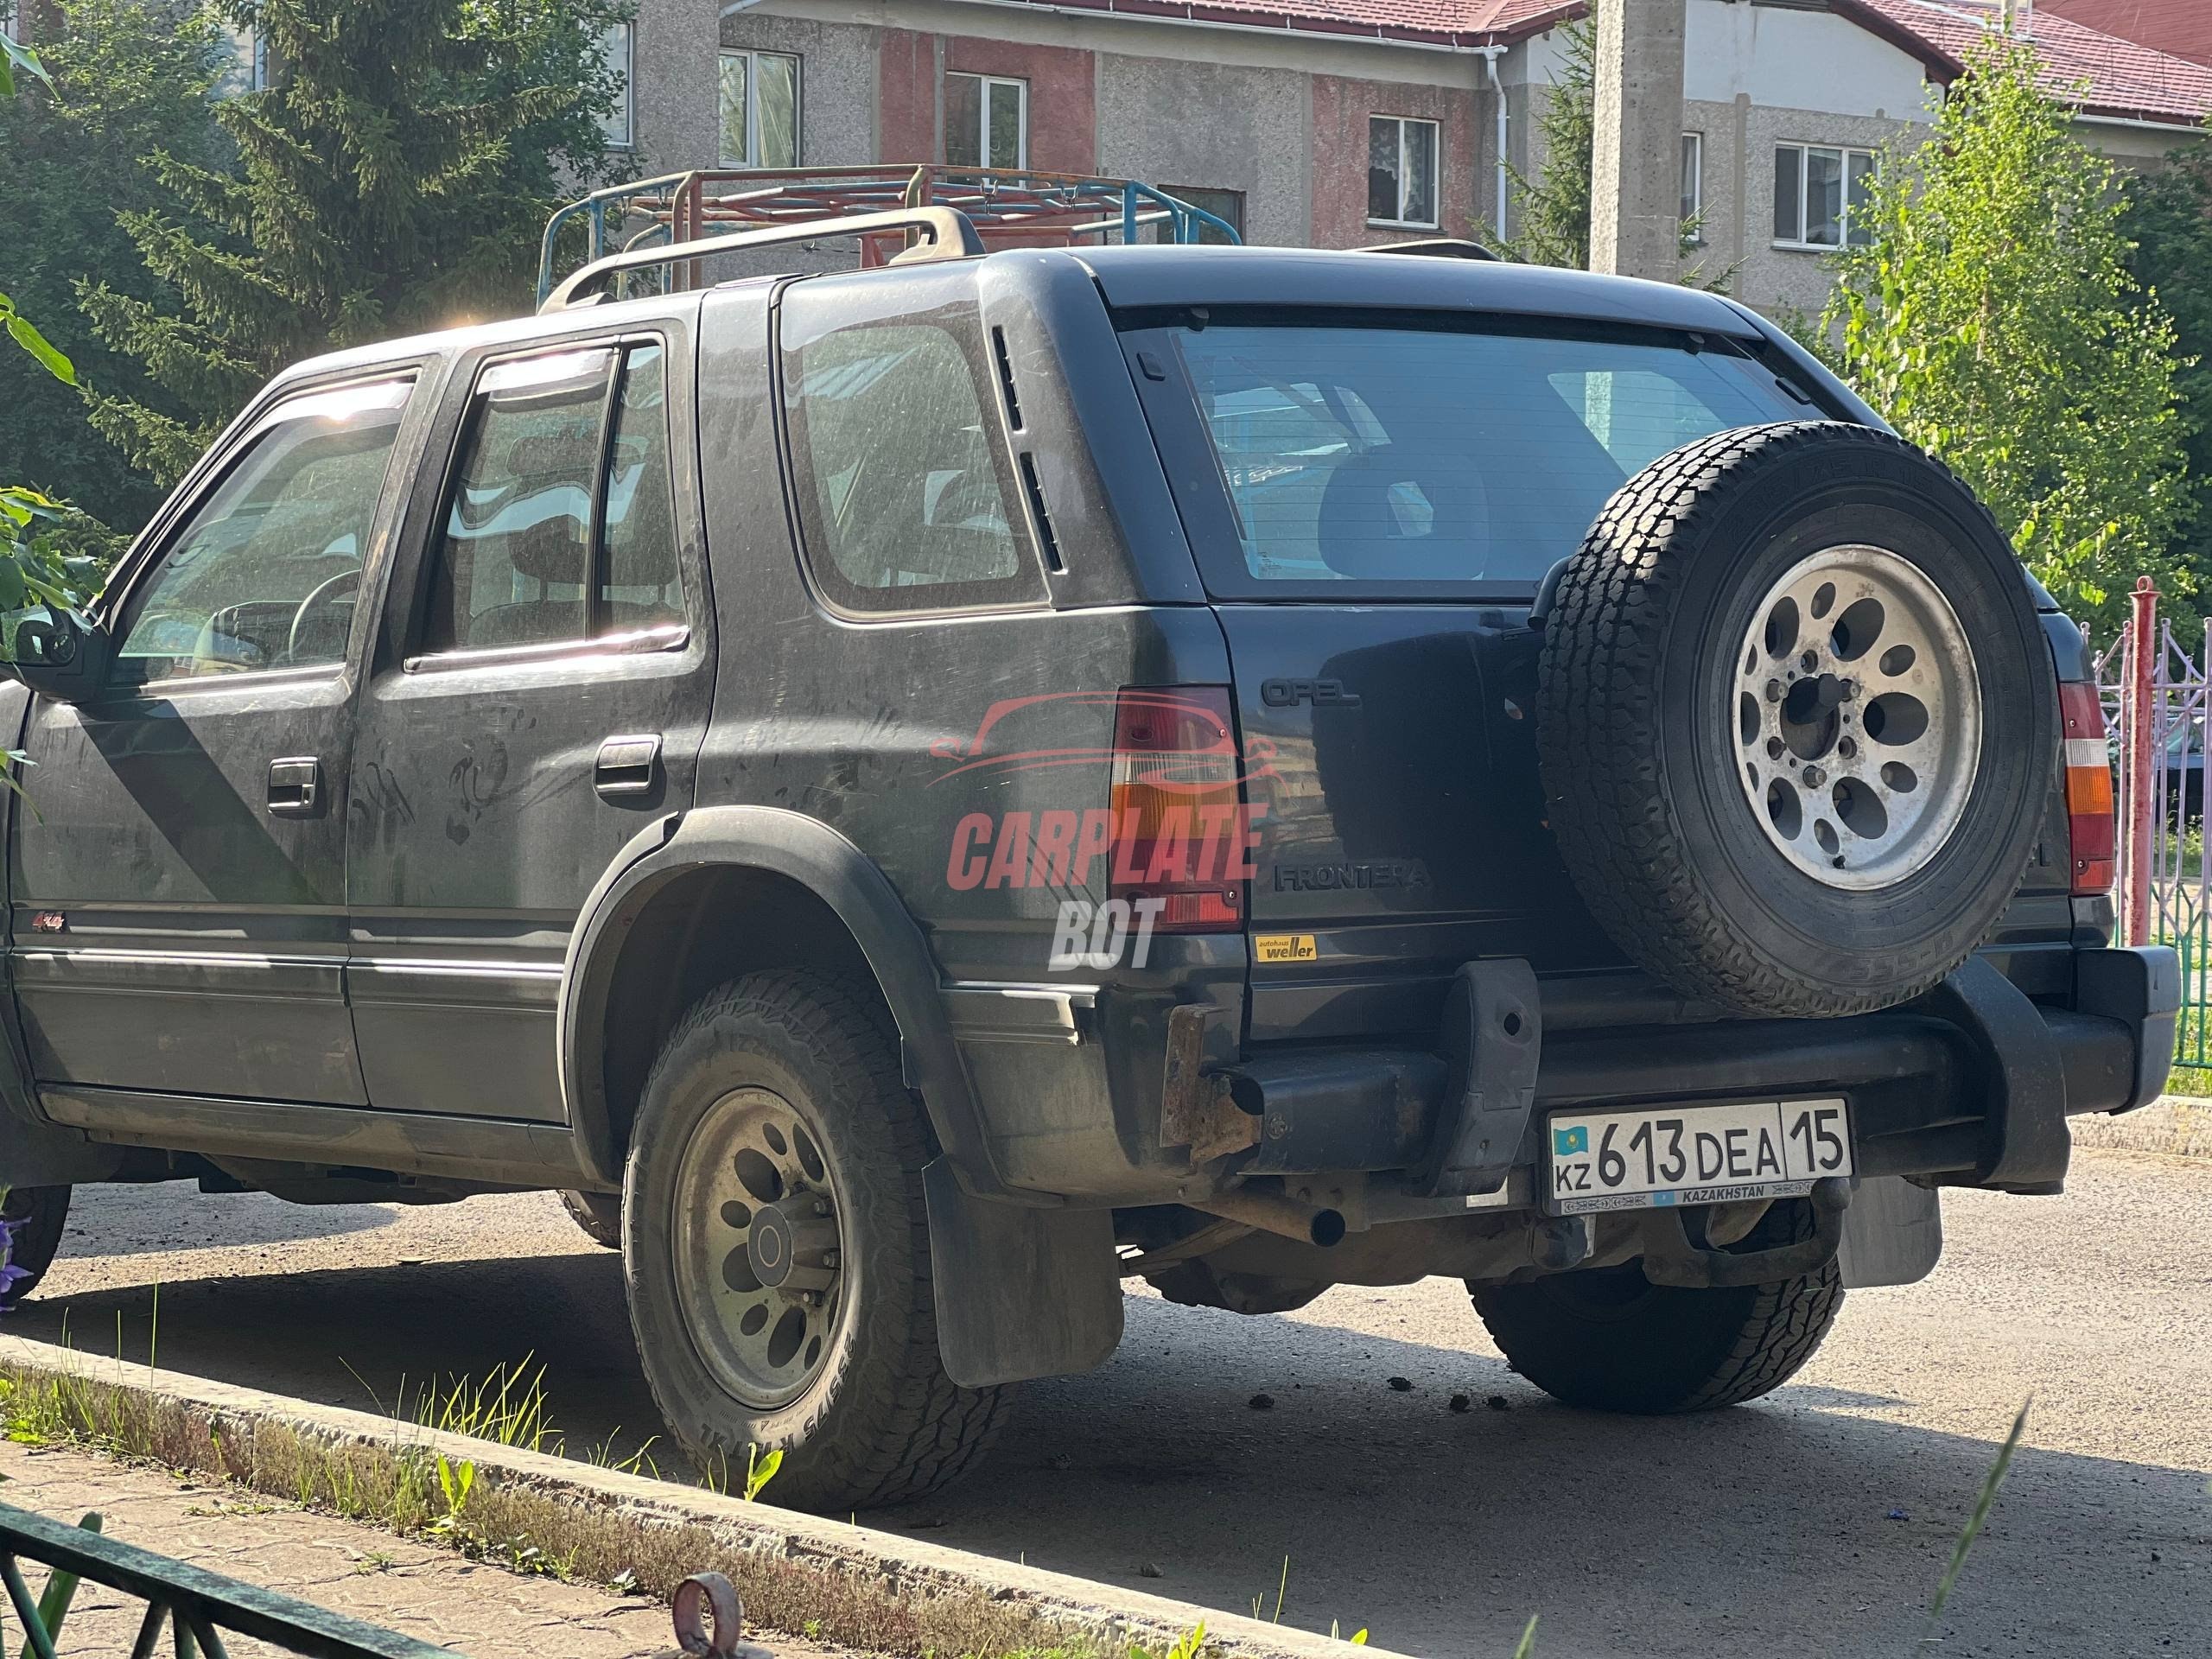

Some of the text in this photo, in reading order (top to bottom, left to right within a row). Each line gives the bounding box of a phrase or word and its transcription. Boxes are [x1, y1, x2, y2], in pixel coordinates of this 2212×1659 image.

[1262, 678, 1362, 707] OPEL
[1274, 861, 1431, 892] FRONTERA
[1259, 939, 1289, 948] autohaus
[1267, 937, 1313, 958] weller
[1599, 1109, 1844, 1187] 613 DEA 15
[1556, 1163, 1592, 1192] KZ
[1684, 1185, 1765, 1203] KAZAKHSTAN
